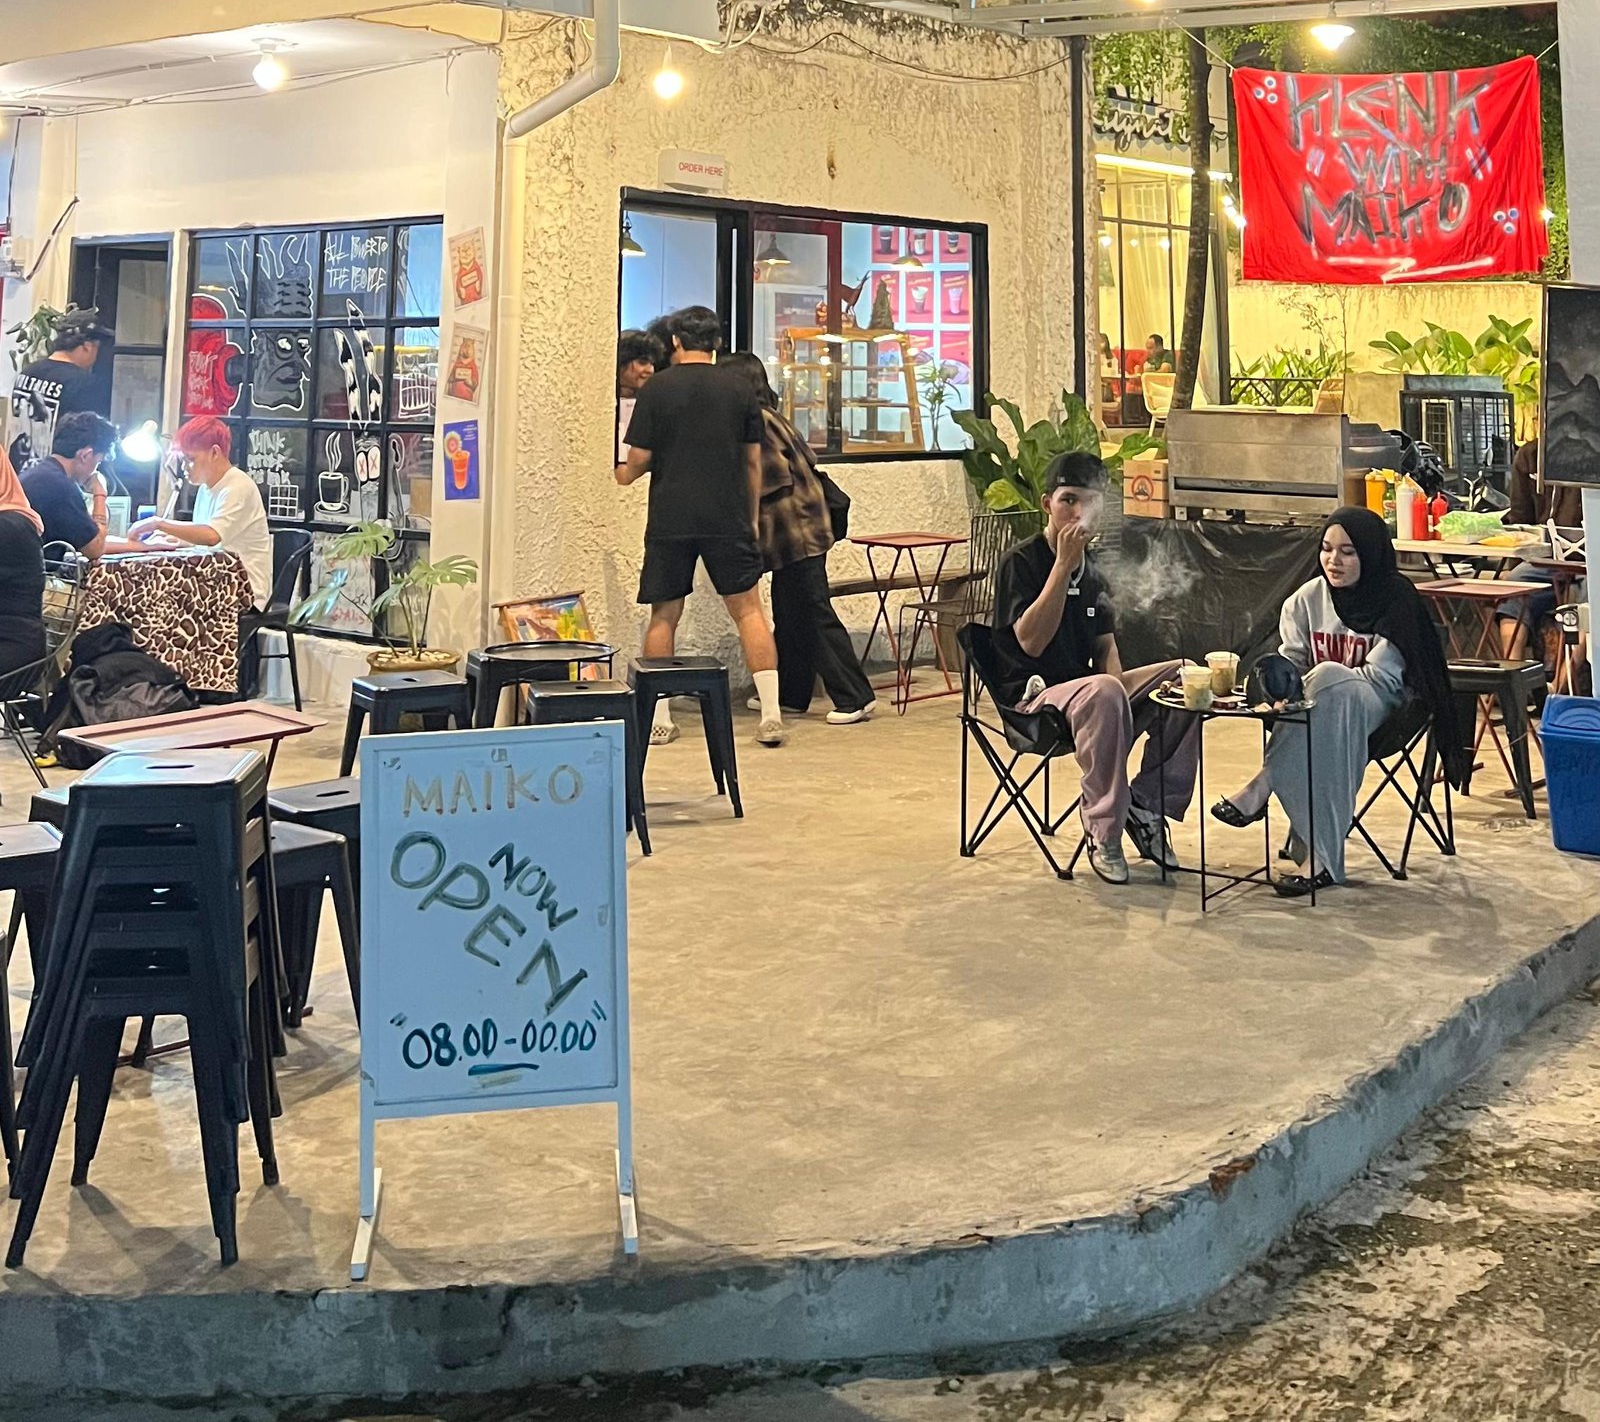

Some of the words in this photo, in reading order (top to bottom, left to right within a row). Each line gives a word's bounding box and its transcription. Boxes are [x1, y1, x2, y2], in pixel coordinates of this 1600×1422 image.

[1285, 71, 1490, 150] KLENK
[678, 161, 704, 174] ORDER
[704, 165, 724, 177] HERE
[1302, 182, 1469, 244] MAIKO
[326, 266, 350, 290] THE
[15, 373, 63, 398] ULTURES
[402, 763, 584, 818] MAIKO
[488, 842, 580, 932] NOW
[389, 830, 590, 1018] OPEN
